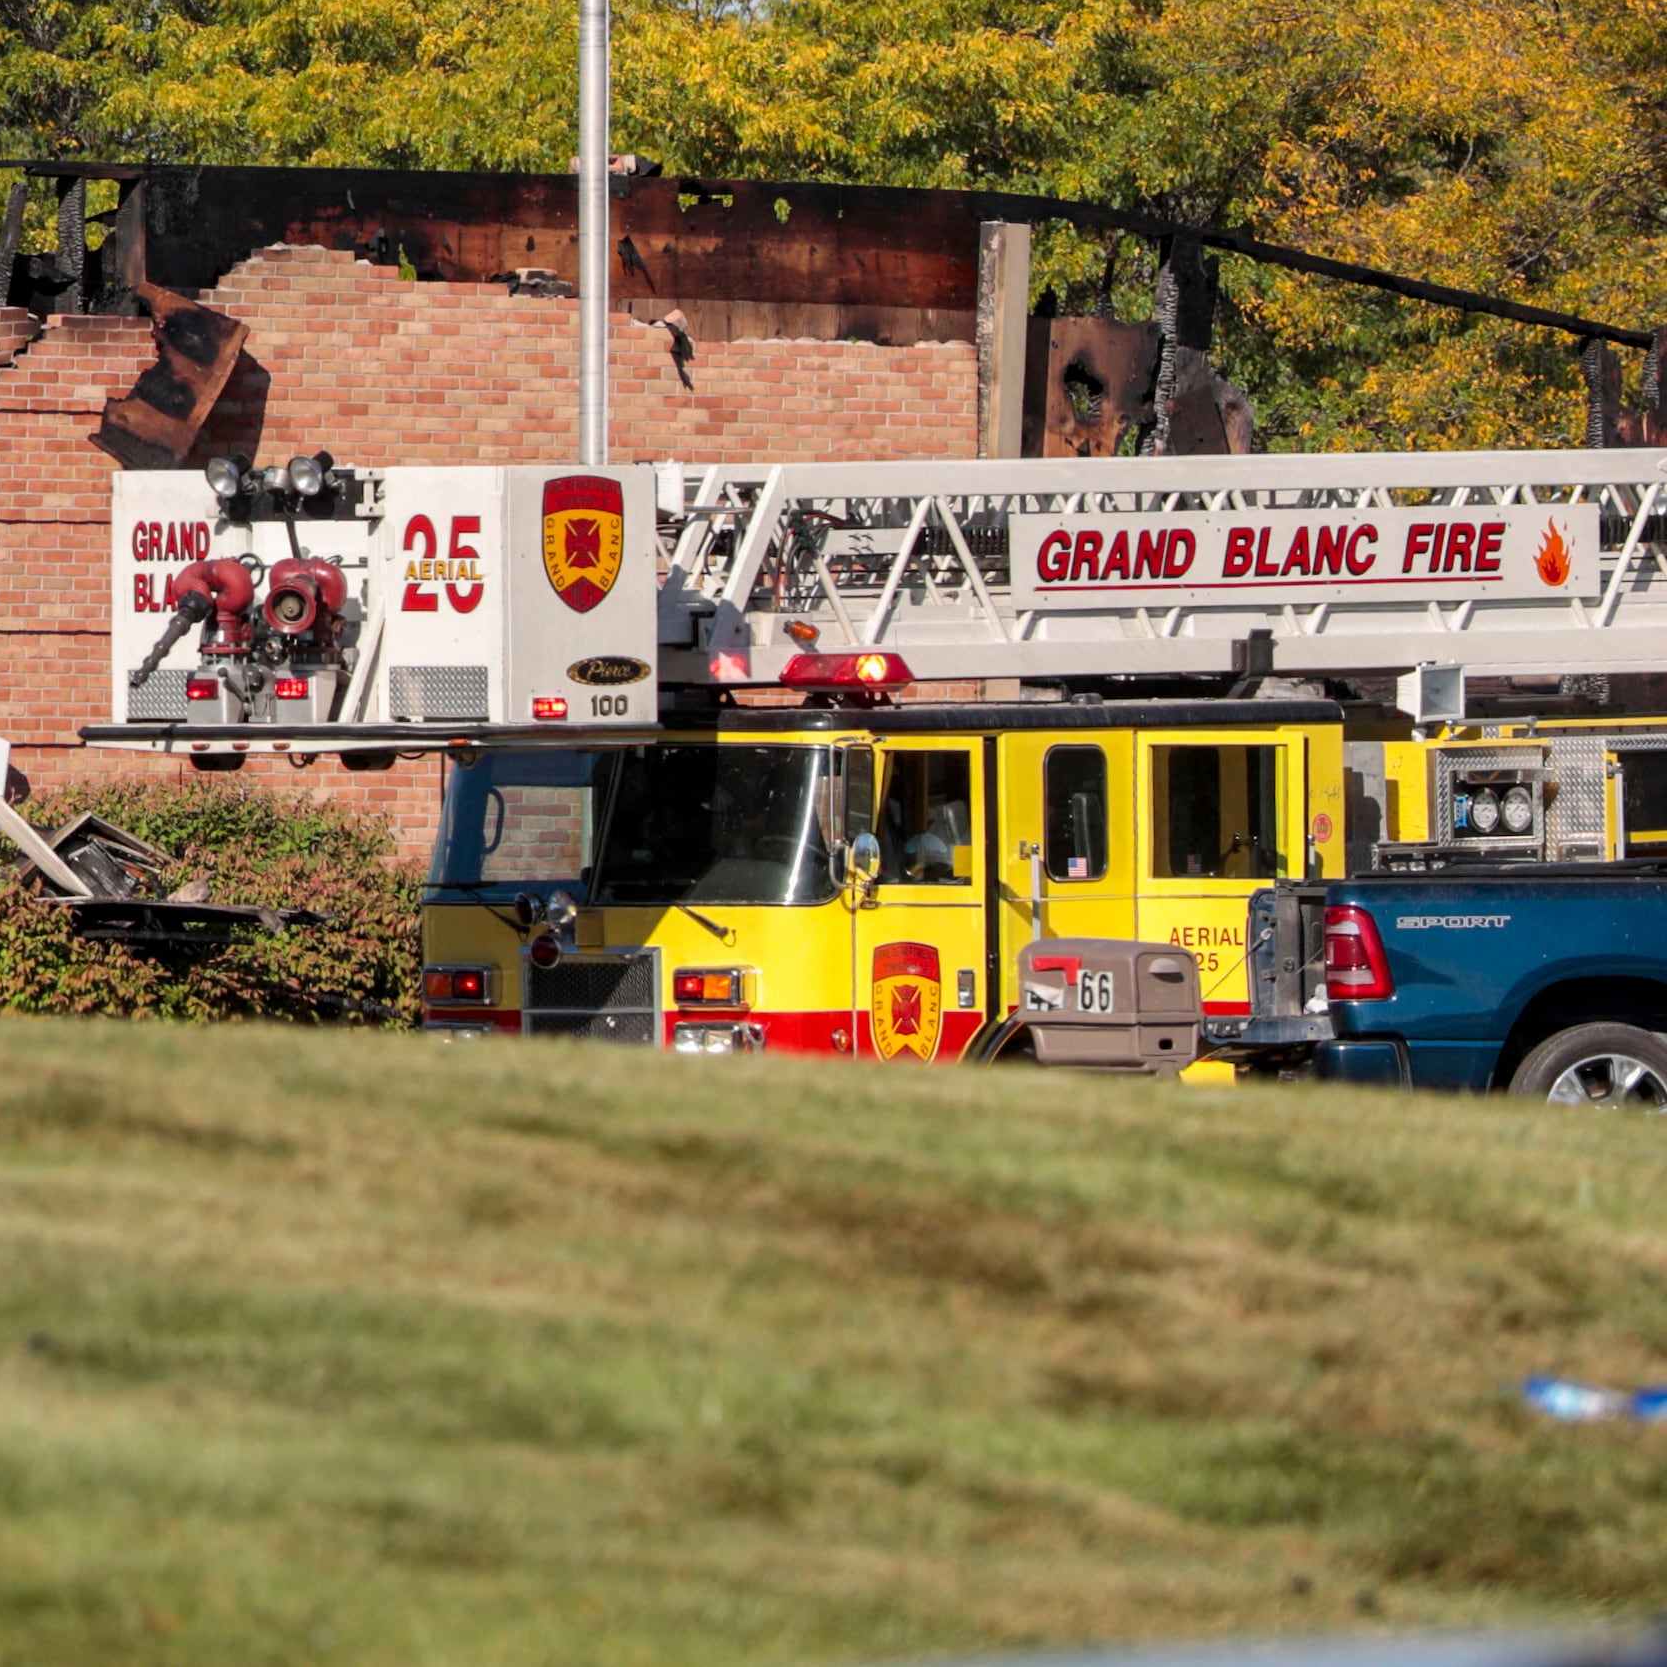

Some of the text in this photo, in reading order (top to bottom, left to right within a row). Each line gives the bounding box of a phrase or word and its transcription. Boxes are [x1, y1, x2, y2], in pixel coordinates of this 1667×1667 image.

[132, 521, 210, 562] GRAND
[546, 518, 565, 588] GRAND
[599, 518, 620, 588] BLANC
[1037, 522, 1506, 582] GRAND BLANC FIRE
[401, 514, 484, 614] 25
[404, 560, 483, 581] AERIAL
[134, 573, 178, 613] BLA
[587, 659, 631, 680] Pierce
[591, 694, 628, 717] 100
[1169, 927, 1244, 946] AERIAL
[1396, 915, 1511, 929] SPORT
[1196, 952, 1219, 972] 25
[1080, 971, 1111, 1012] 66
[875, 984, 893, 1055] GRAND
[919, 986, 938, 1056] BLANC
